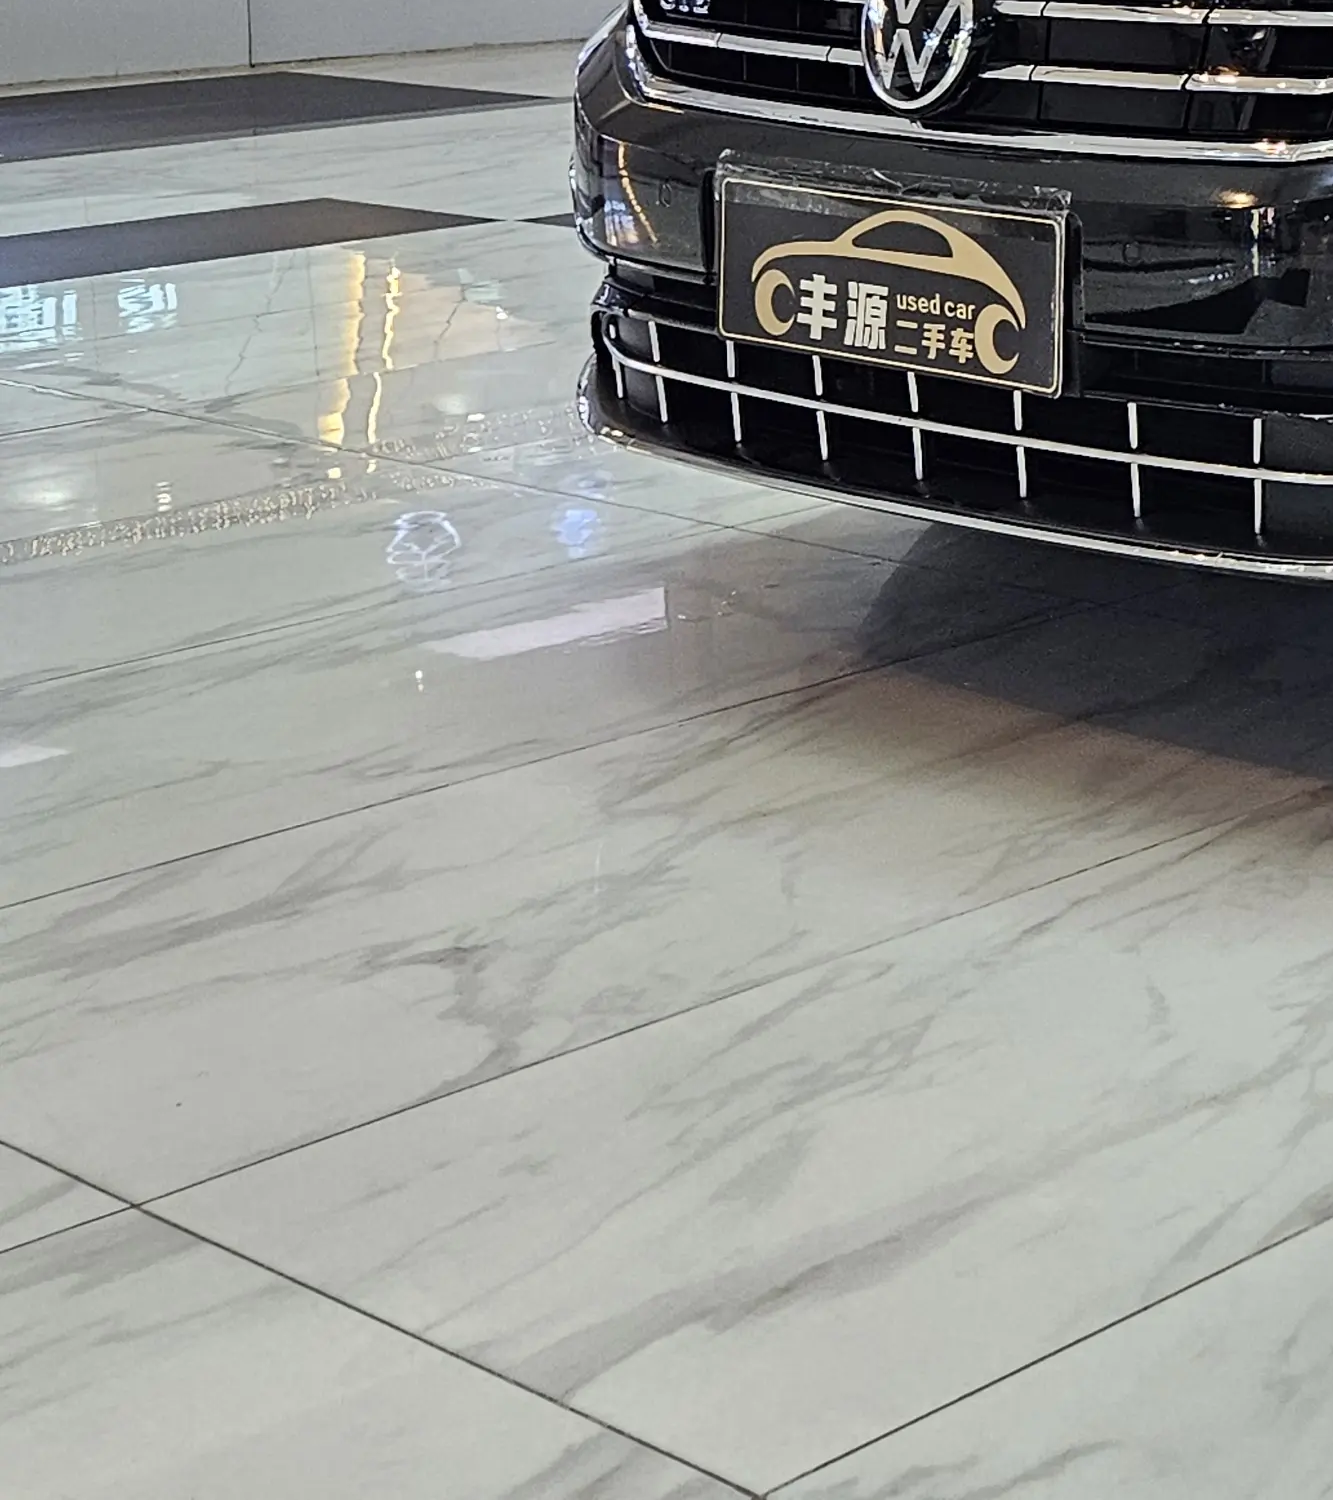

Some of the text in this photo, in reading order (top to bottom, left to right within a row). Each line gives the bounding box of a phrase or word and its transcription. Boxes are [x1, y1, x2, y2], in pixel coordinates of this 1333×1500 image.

[796, 273, 889, 350] 丰源
[895, 292, 976, 321] used car
[894, 319, 975, 365] 二手车
